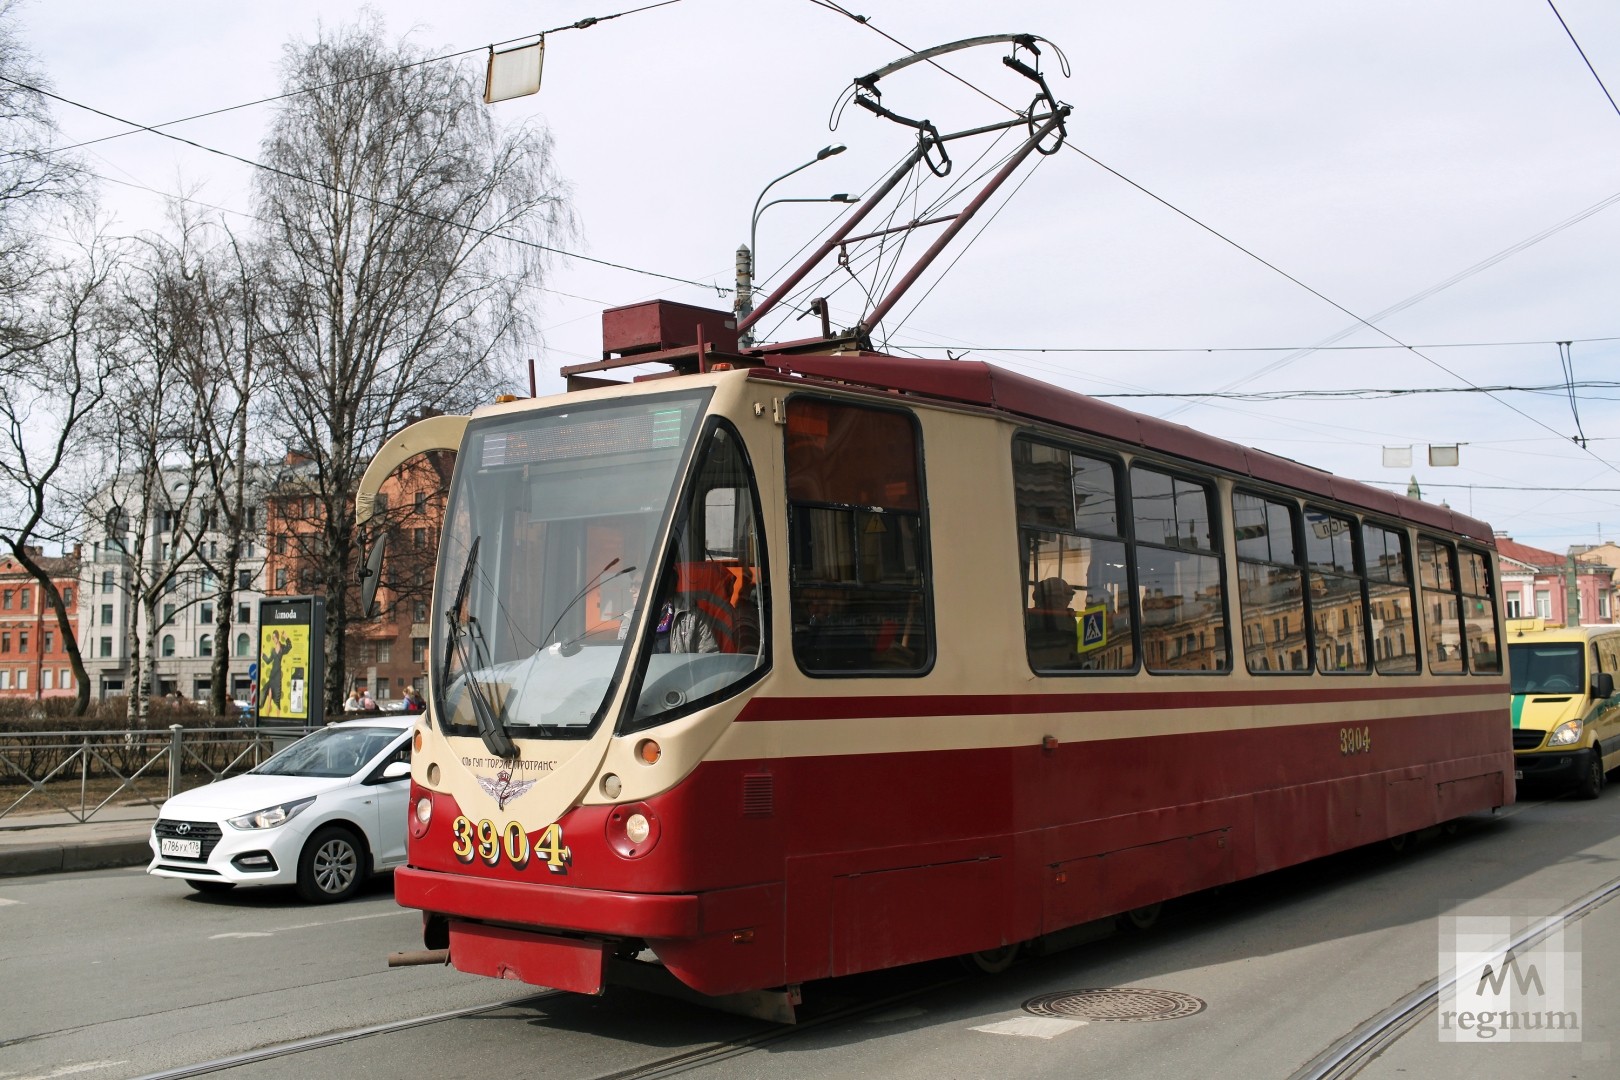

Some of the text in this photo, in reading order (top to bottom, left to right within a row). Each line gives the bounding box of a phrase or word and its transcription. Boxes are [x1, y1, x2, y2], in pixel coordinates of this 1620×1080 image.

[275, 609, 296, 619] lamoda
[1340, 726, 1371, 754] 3904
[472, 758, 484, 767] ГУП
[453, 816, 572, 874] 3904
